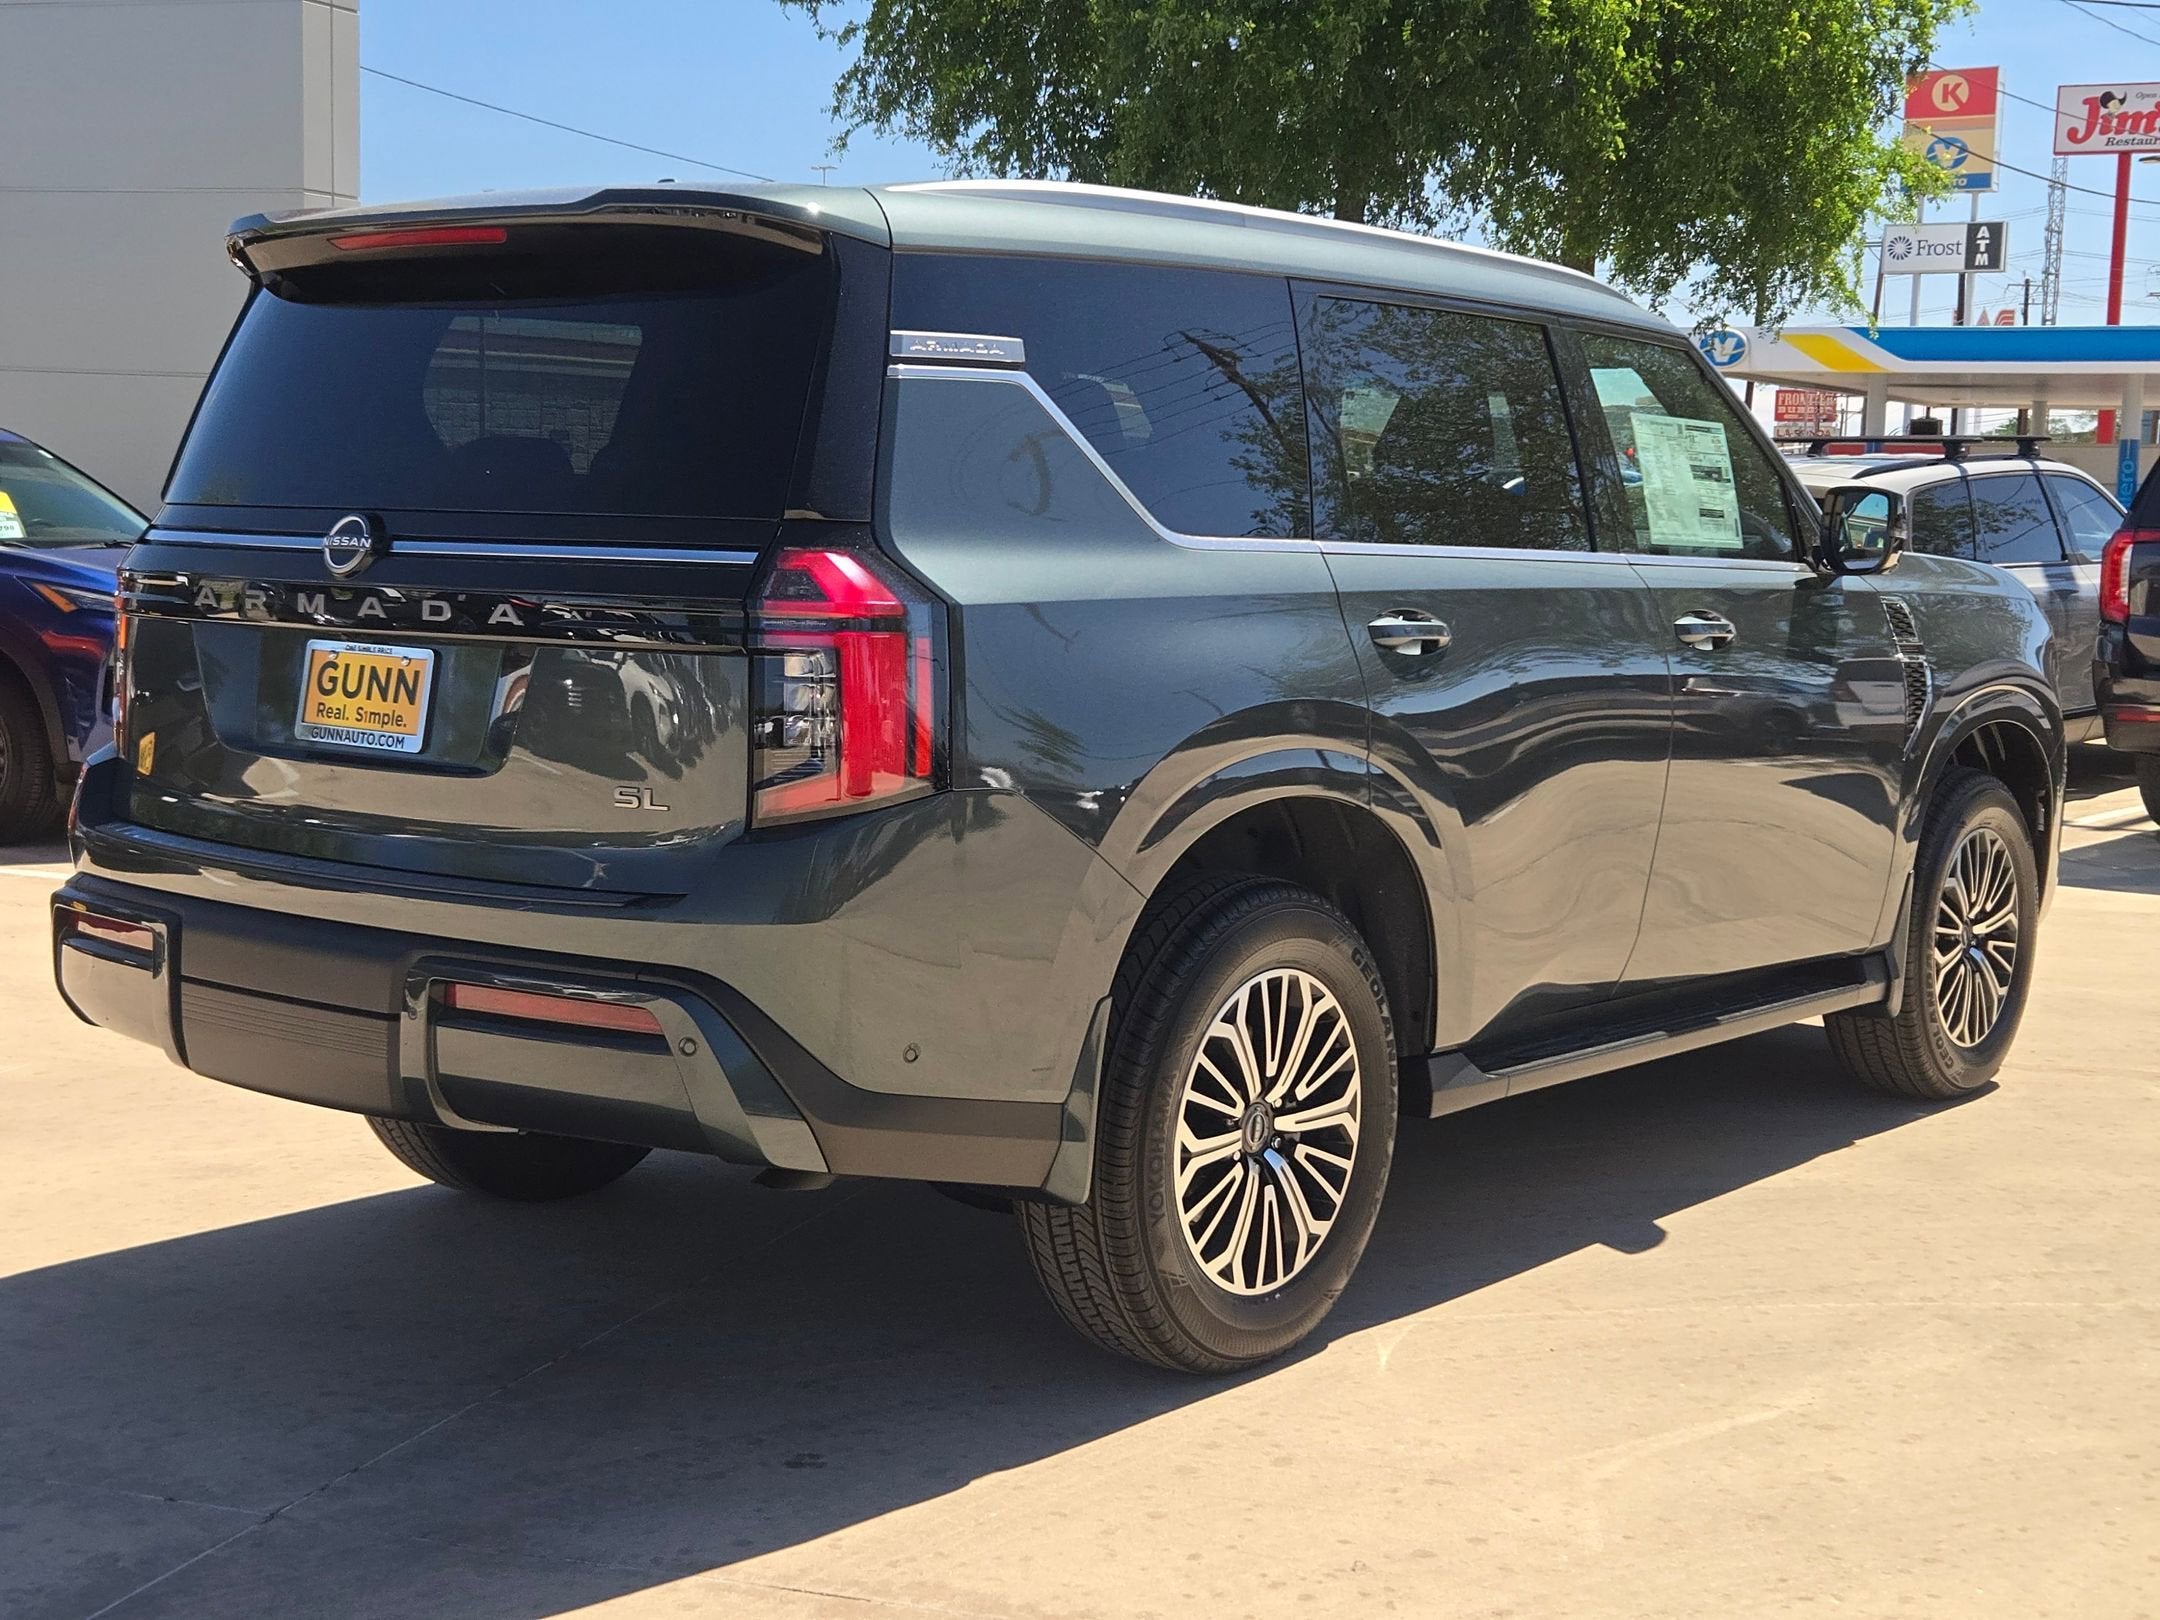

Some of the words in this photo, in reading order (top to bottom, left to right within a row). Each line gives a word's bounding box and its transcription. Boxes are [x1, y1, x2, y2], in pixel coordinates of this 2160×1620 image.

[1916, 239, 1963, 256] Frost
[1974, 226, 1990, 266] ATM
[323, 537, 371, 548] NISSAN
[194, 586, 525, 626] ARMADA
[317, 661, 420, 706] GUNN
[316, 702, 349, 721] Real.
[311, 727, 405, 749] GUNNAUTO.COM
[614, 785, 670, 811] SL
